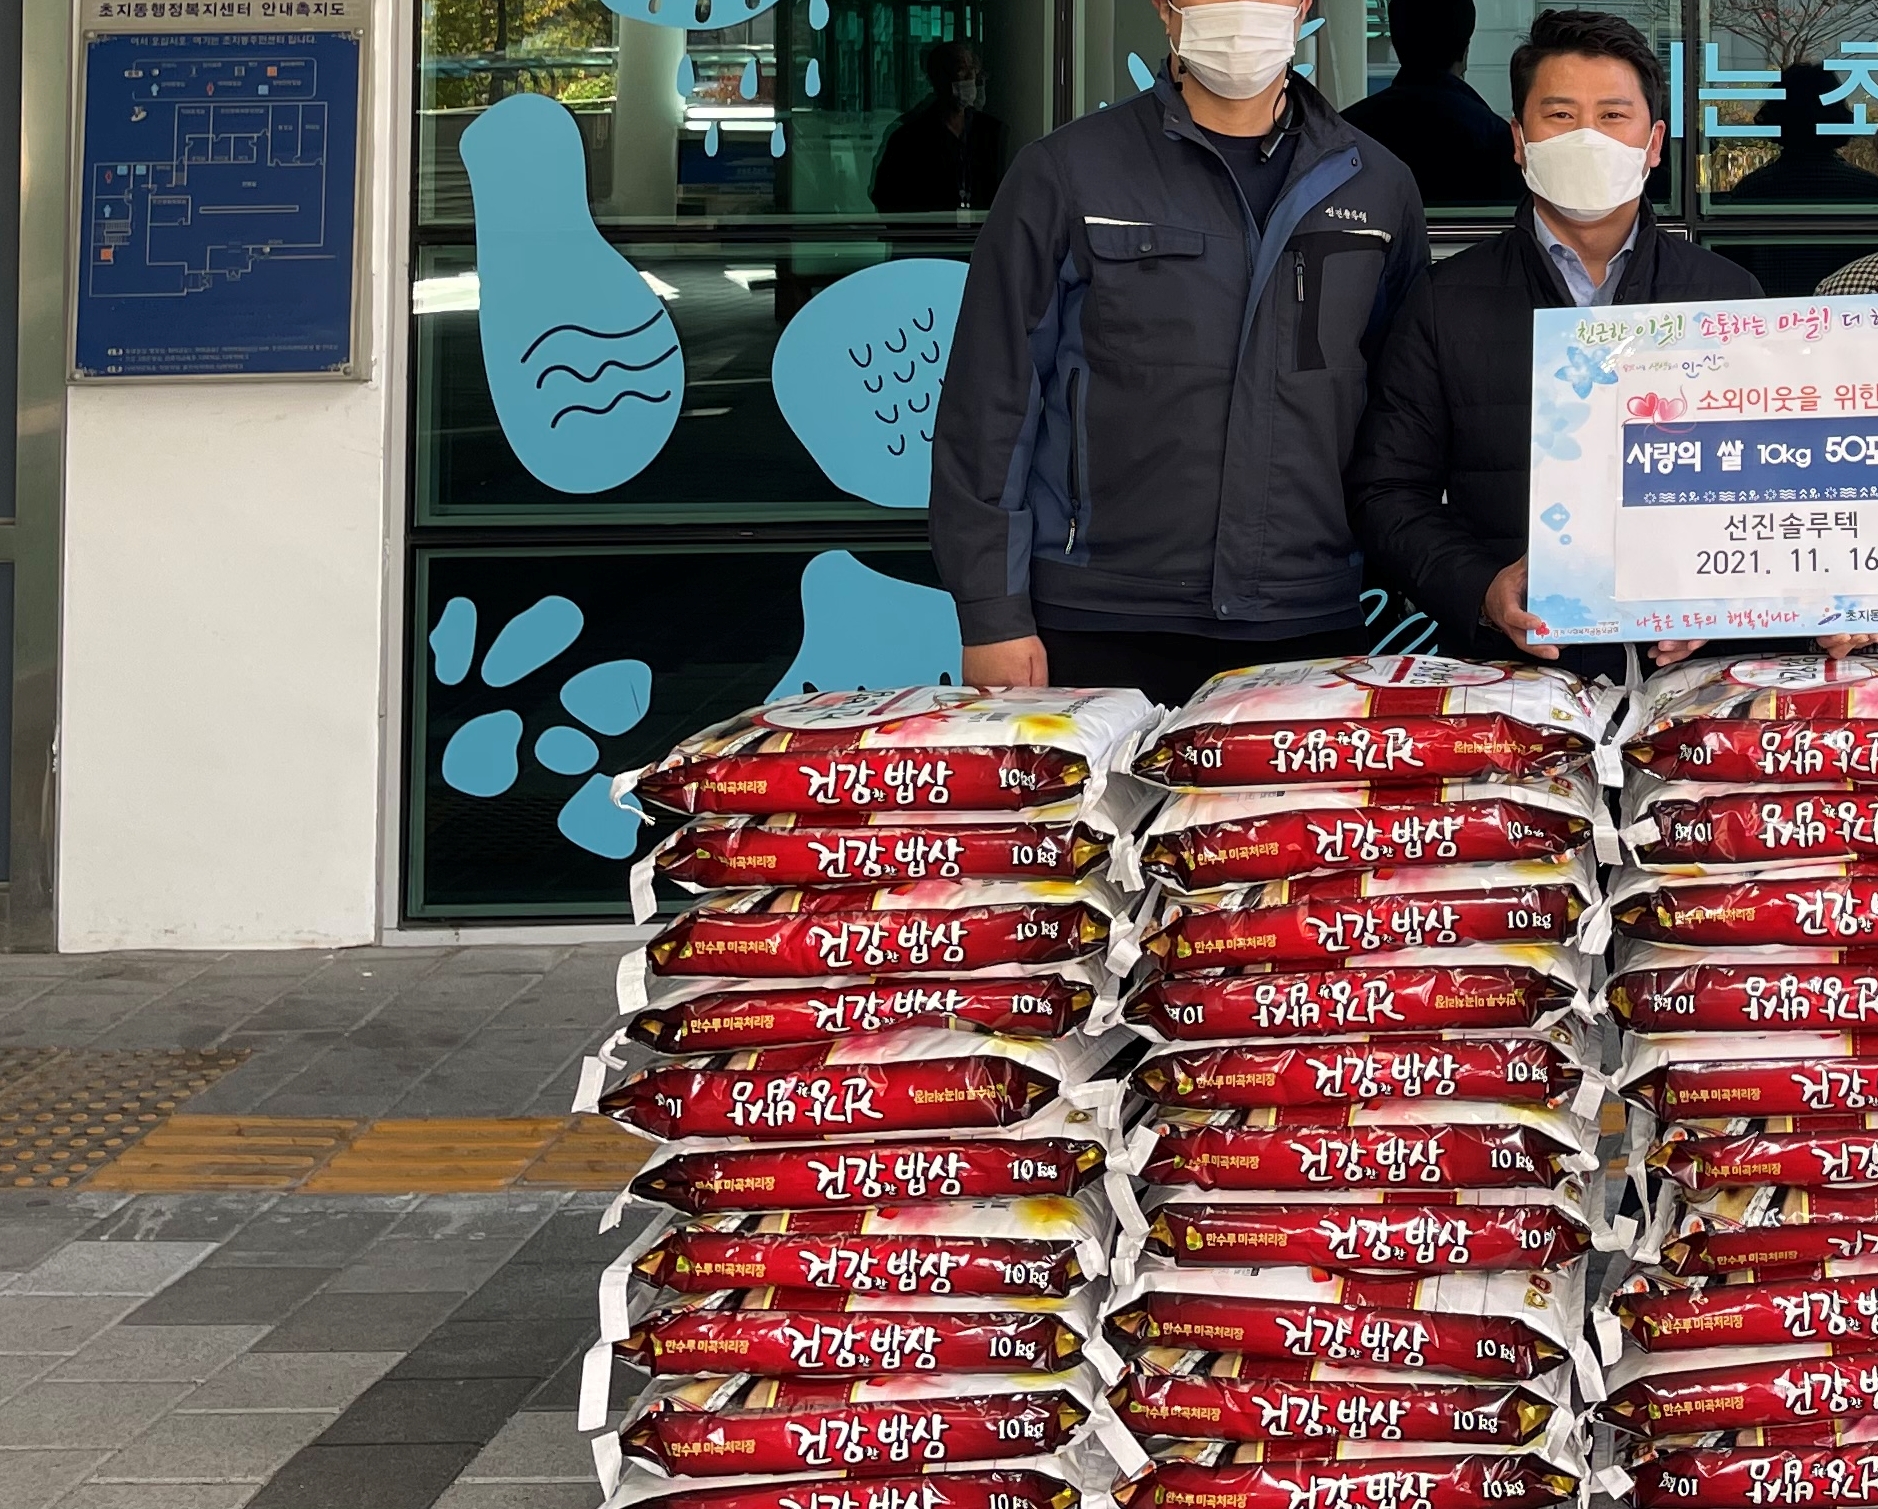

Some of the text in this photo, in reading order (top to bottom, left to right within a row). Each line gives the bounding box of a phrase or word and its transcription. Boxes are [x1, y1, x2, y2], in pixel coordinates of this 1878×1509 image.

[98, 2, 251, 18] 초지동행정복지센터
[1577, 319, 1628, 342] 친근한
[1634, 314, 1684, 346] 이웃!
[1701, 313, 1766, 341] 소통하는
[1779, 307, 1830, 340] 마을!
[1842, 312, 1860, 327] 더
[1696, 386, 1822, 413] 소외이웃을
[1626, 441, 1702, 474] 사랑의
[1716, 439, 1744, 472] 쌀
[1757, 443, 1812, 468] 10kg
[1724, 511, 1859, 542] 선진솔루텍
[1696, 549, 1771, 575] 2021.
[1790, 548, 1830, 573] 11.
[1636, 613, 1674, 633] 나눔은
[1682, 612, 1717, 629] 모두의
[884, 761, 953, 803] 밥상
[898, 922, 967, 961] 밥상
[1393, 908, 1460, 945] 밥상
[1393, 1054, 1460, 1095] 밥상
[895, 1154, 968, 1195] 밥상
[870, 1323, 942, 1369] 밥상
[1360, 1324, 1429, 1365] 밥상
[877, 1415, 949, 1460] 밥상
